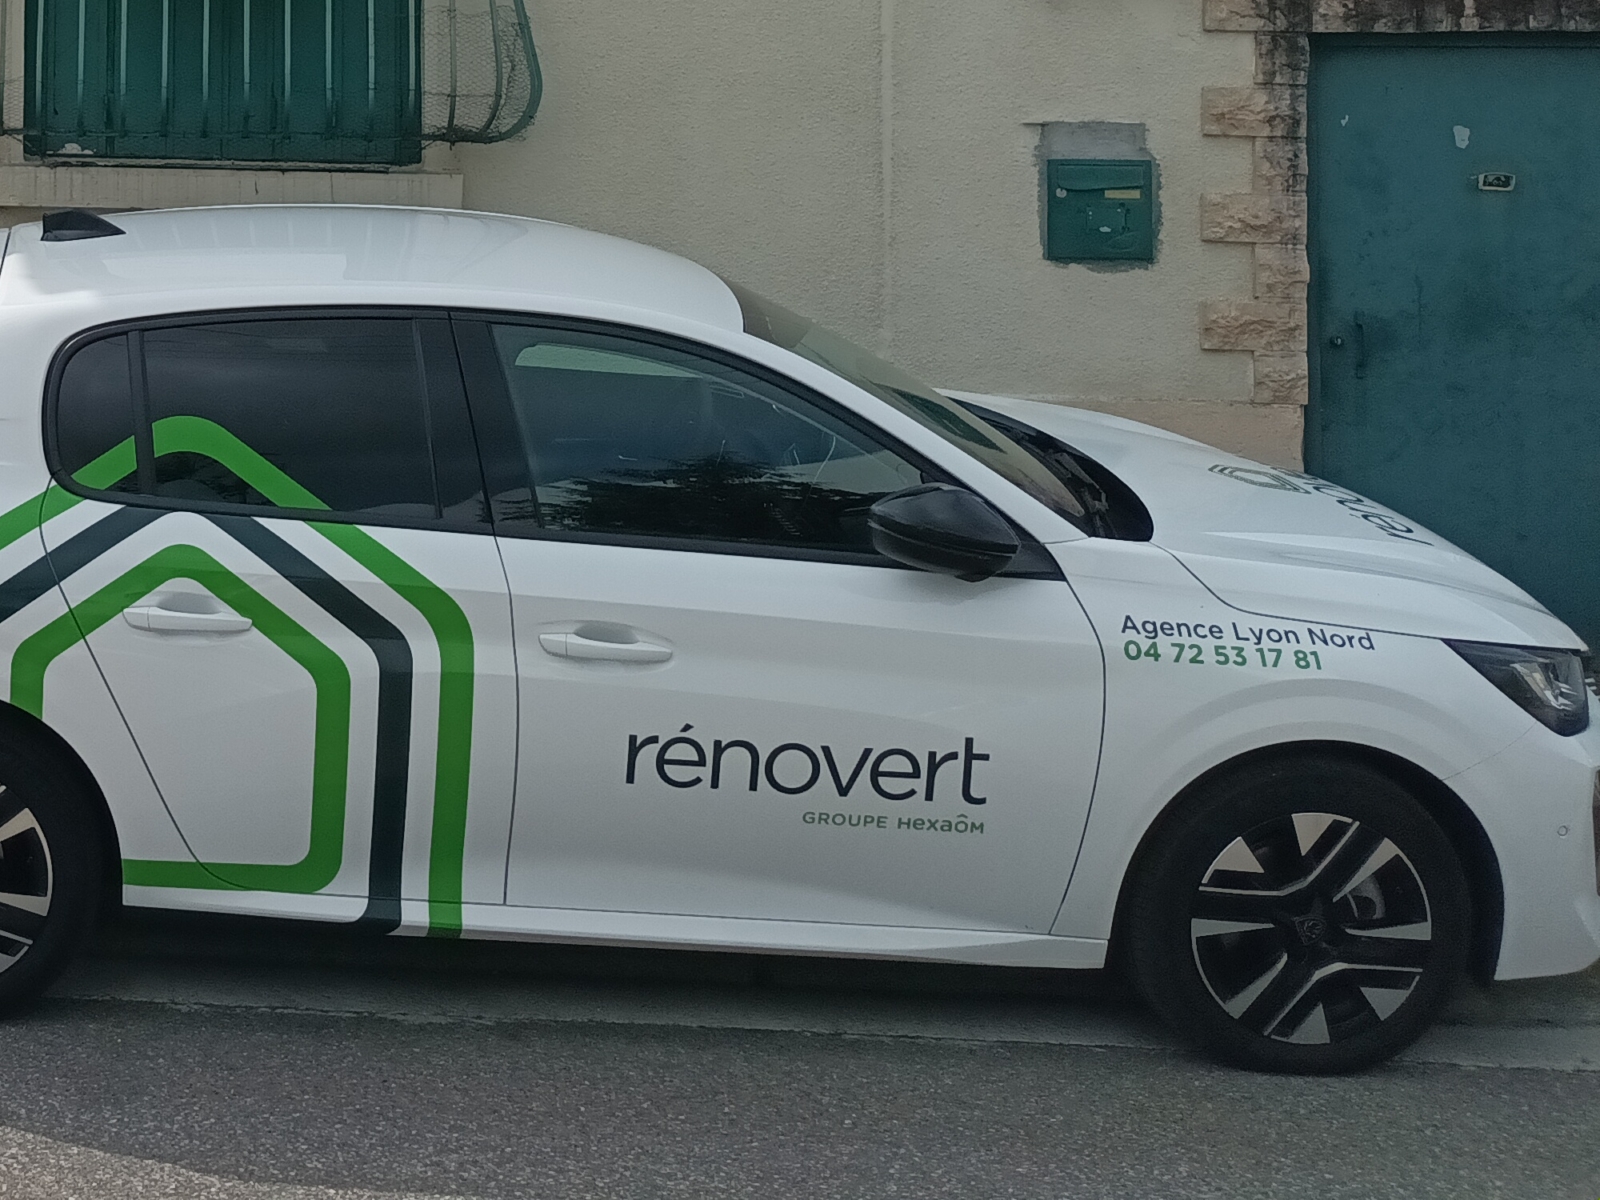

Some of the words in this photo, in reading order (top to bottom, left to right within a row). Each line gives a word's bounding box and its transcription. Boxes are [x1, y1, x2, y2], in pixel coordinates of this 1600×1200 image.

[1121, 615, 1224, 640] Agence
[1231, 622, 1301, 646] Lyon
[1306, 627, 1376, 651] Nord
[1123, 639, 1162, 662] 04
[1170, 642, 1205, 665] 72
[1213, 645, 1248, 667] 53
[1255, 648, 1283, 668] 17
[1293, 649, 1322, 671] 81
[625, 722, 990, 806] rénovert
[801, 810, 889, 829] GROUPE
